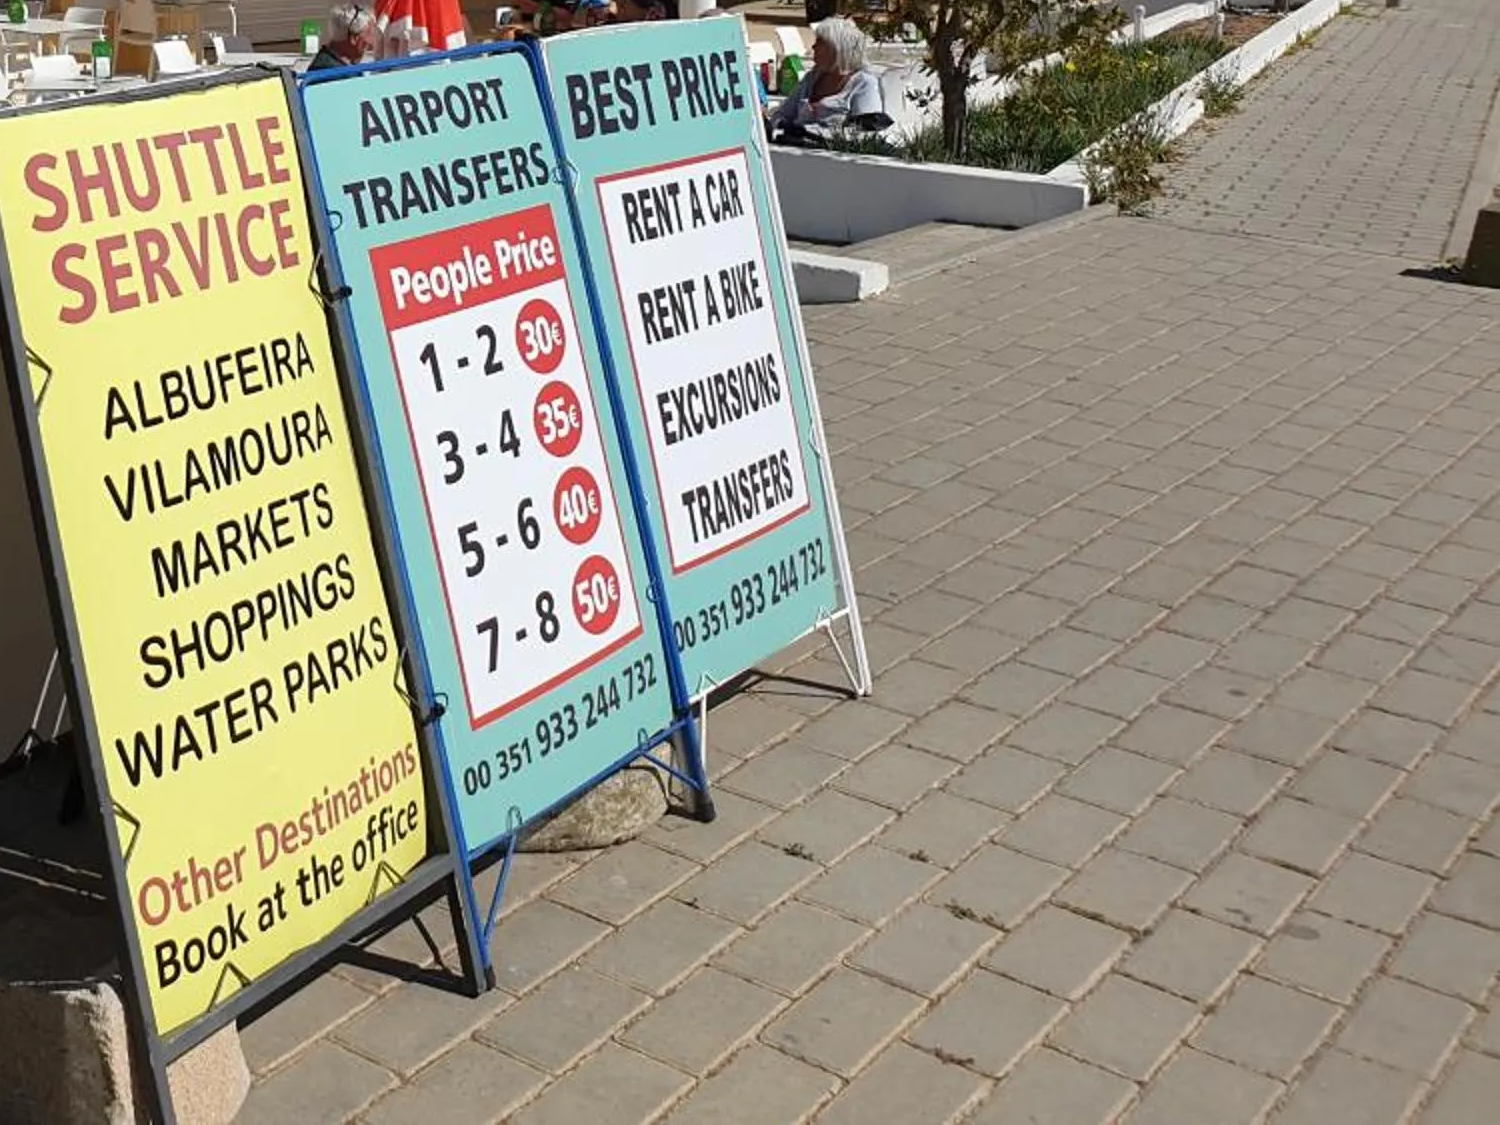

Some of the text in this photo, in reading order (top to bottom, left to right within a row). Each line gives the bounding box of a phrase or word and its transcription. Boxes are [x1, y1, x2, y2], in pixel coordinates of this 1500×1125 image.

[359, 78, 509, 148] AIRPORT
[565, 50, 745, 140] BEST PRICE
[23, 116, 291, 232] SHUTTLE
[343, 141, 550, 229] TRANSFERS
[621, 169, 744, 244] RENT A CAR
[52, 198, 300, 324] SERVICE
[389, 231, 556, 310] People Price
[637, 260, 764, 345] RENT A BIKE
[104, 331, 315, 440] ALBUFEIRA
[519, 315, 563, 361] 30€
[537, 396, 580, 444] 35€
[656, 353, 781, 446] EXCURSIONS
[103, 403, 333, 521] VILAMOURA
[559, 483, 599, 529] 40€
[681, 448, 794, 544] TRANSFERS
[151, 482, 333, 597] MARKETS
[140, 553, 355, 688] SHOPPINGS
[576, 572, 618, 623] 50€
[673, 538, 827, 652] 00 351 933 244 732
[115, 616, 388, 787] WATER PARKS
[463, 652, 657, 796] 00 351 933 244 732
[138, 742, 416, 926] Other Destinations
[154, 799, 419, 988] Book at the office
